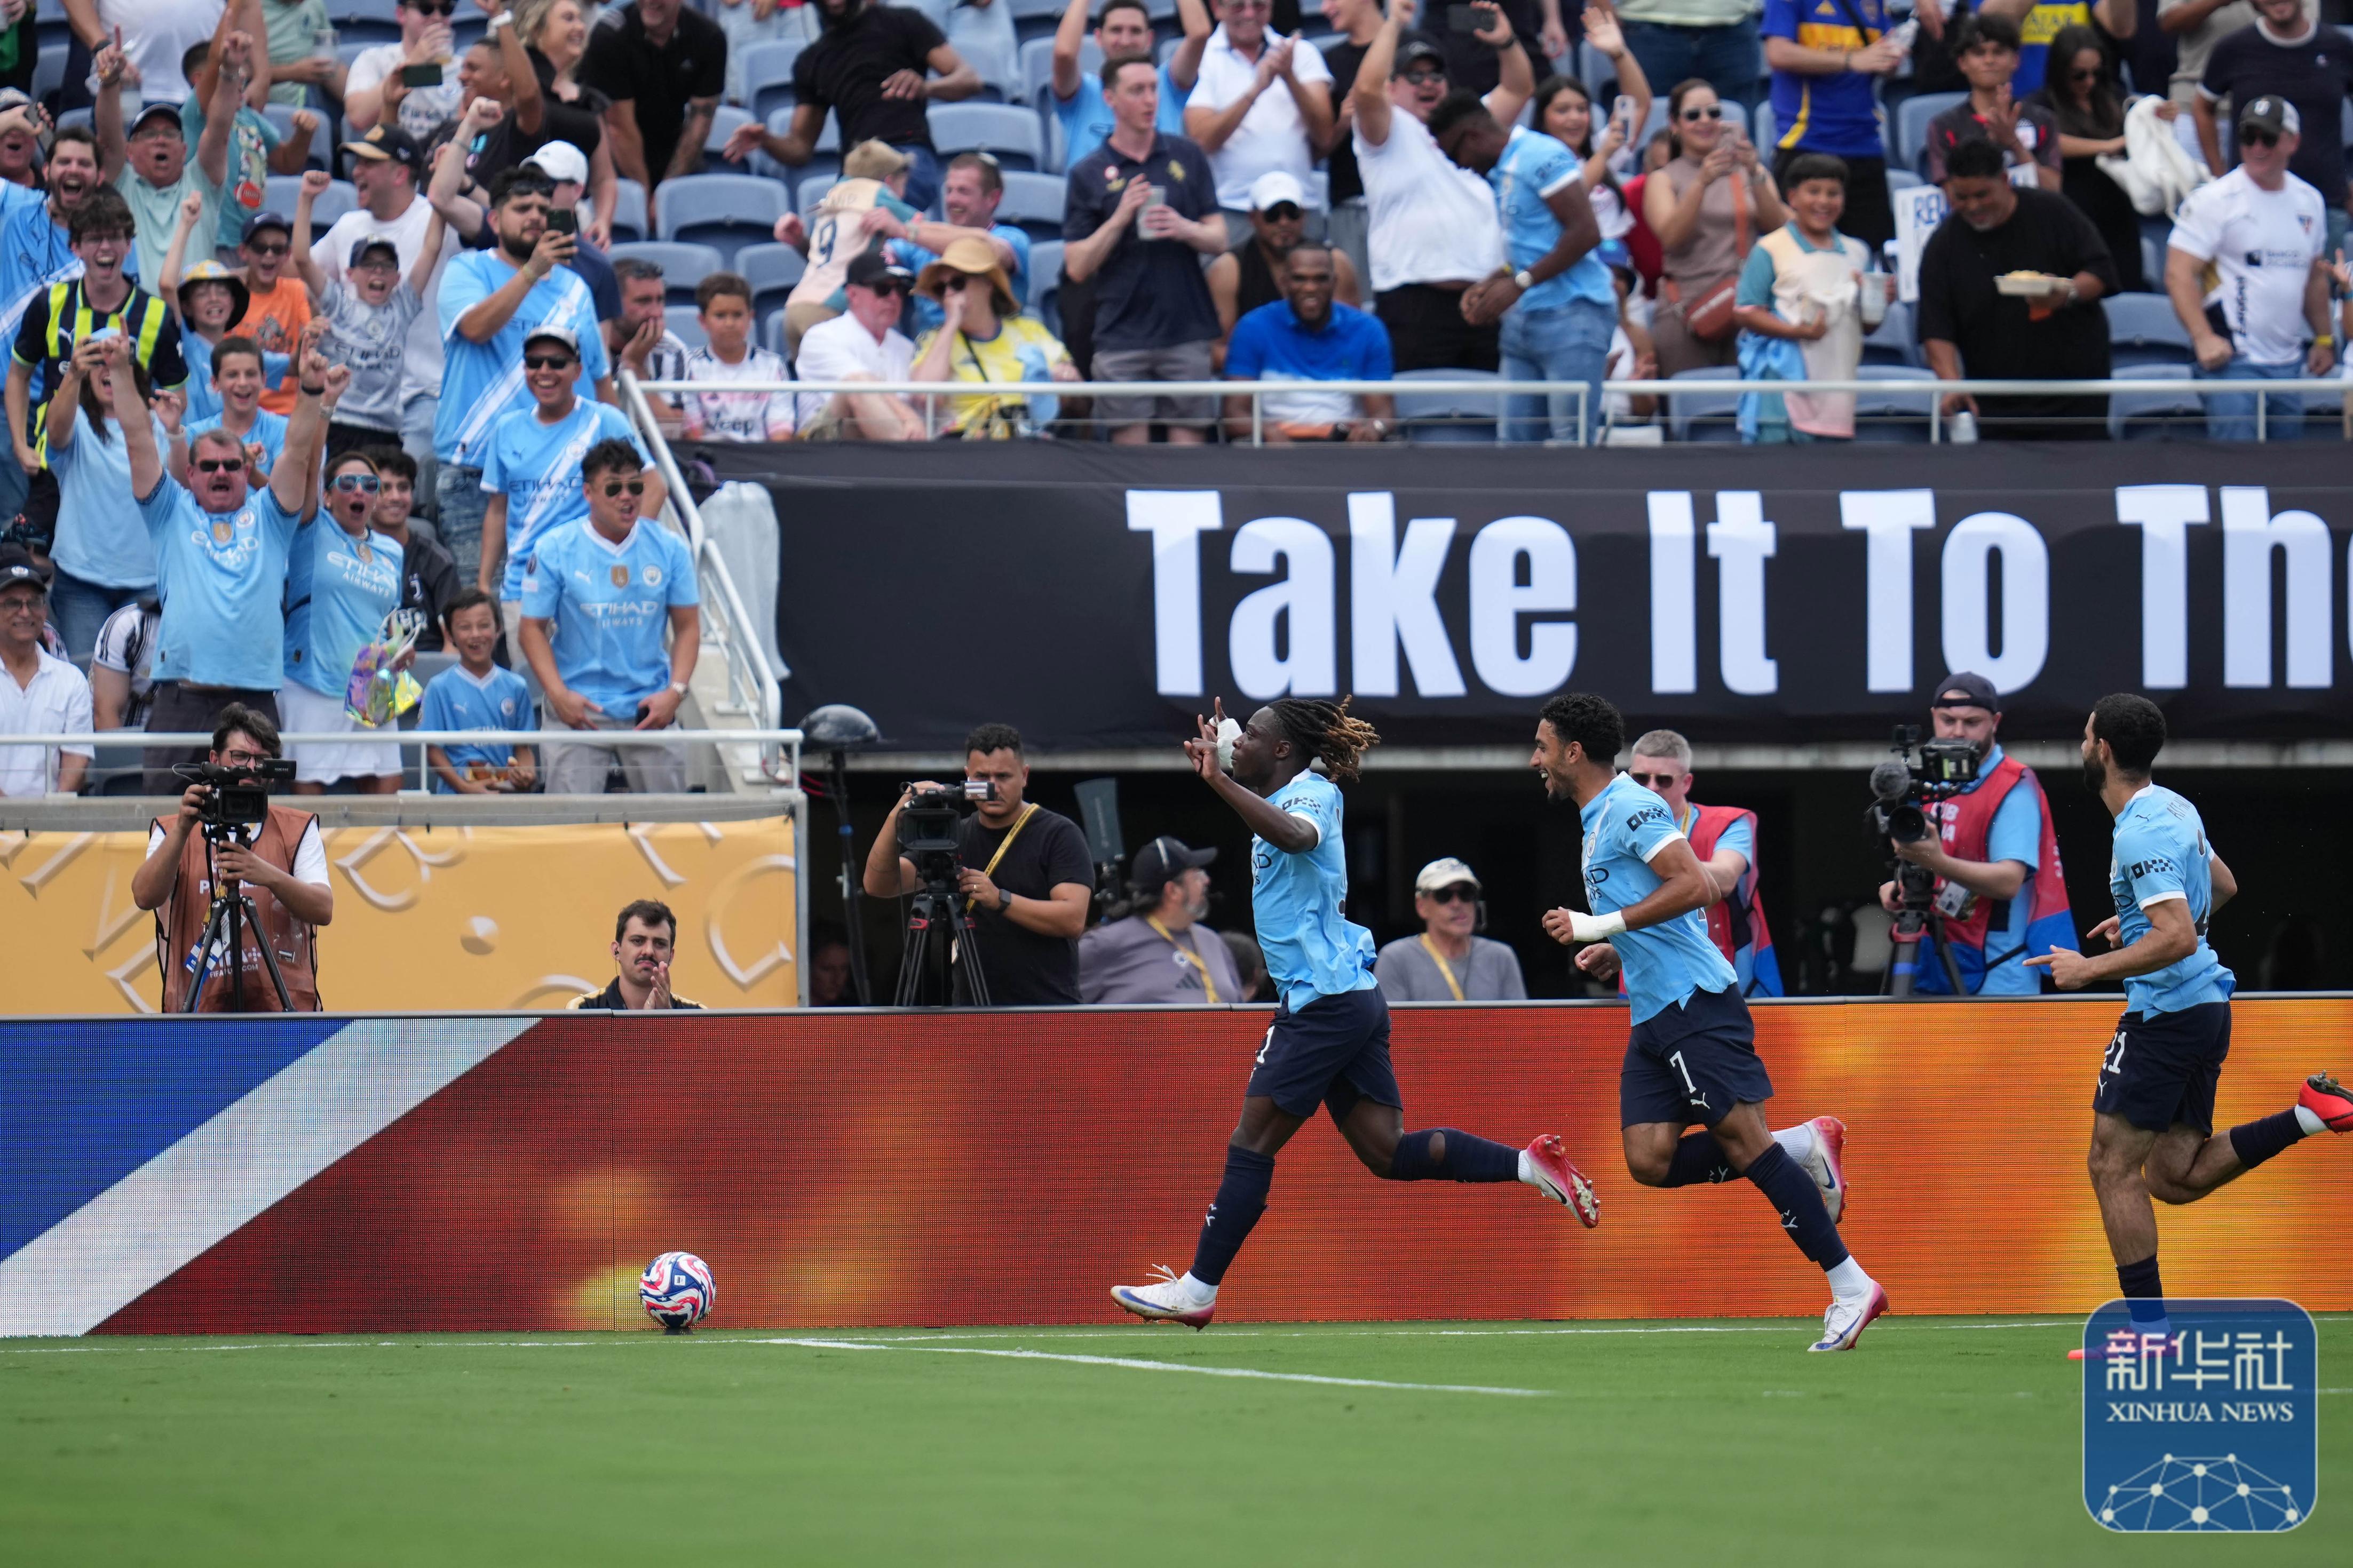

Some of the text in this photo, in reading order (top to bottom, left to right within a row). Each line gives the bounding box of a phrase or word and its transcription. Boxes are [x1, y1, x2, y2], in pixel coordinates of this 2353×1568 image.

[818, 218, 837, 268] 9
[327, 551, 397, 587] ETIHA
[1126, 484, 2353, 700] Take It To Th
[1256, 1025, 1275, 1063] 1
[1669, 1050, 1697, 1094] 7
